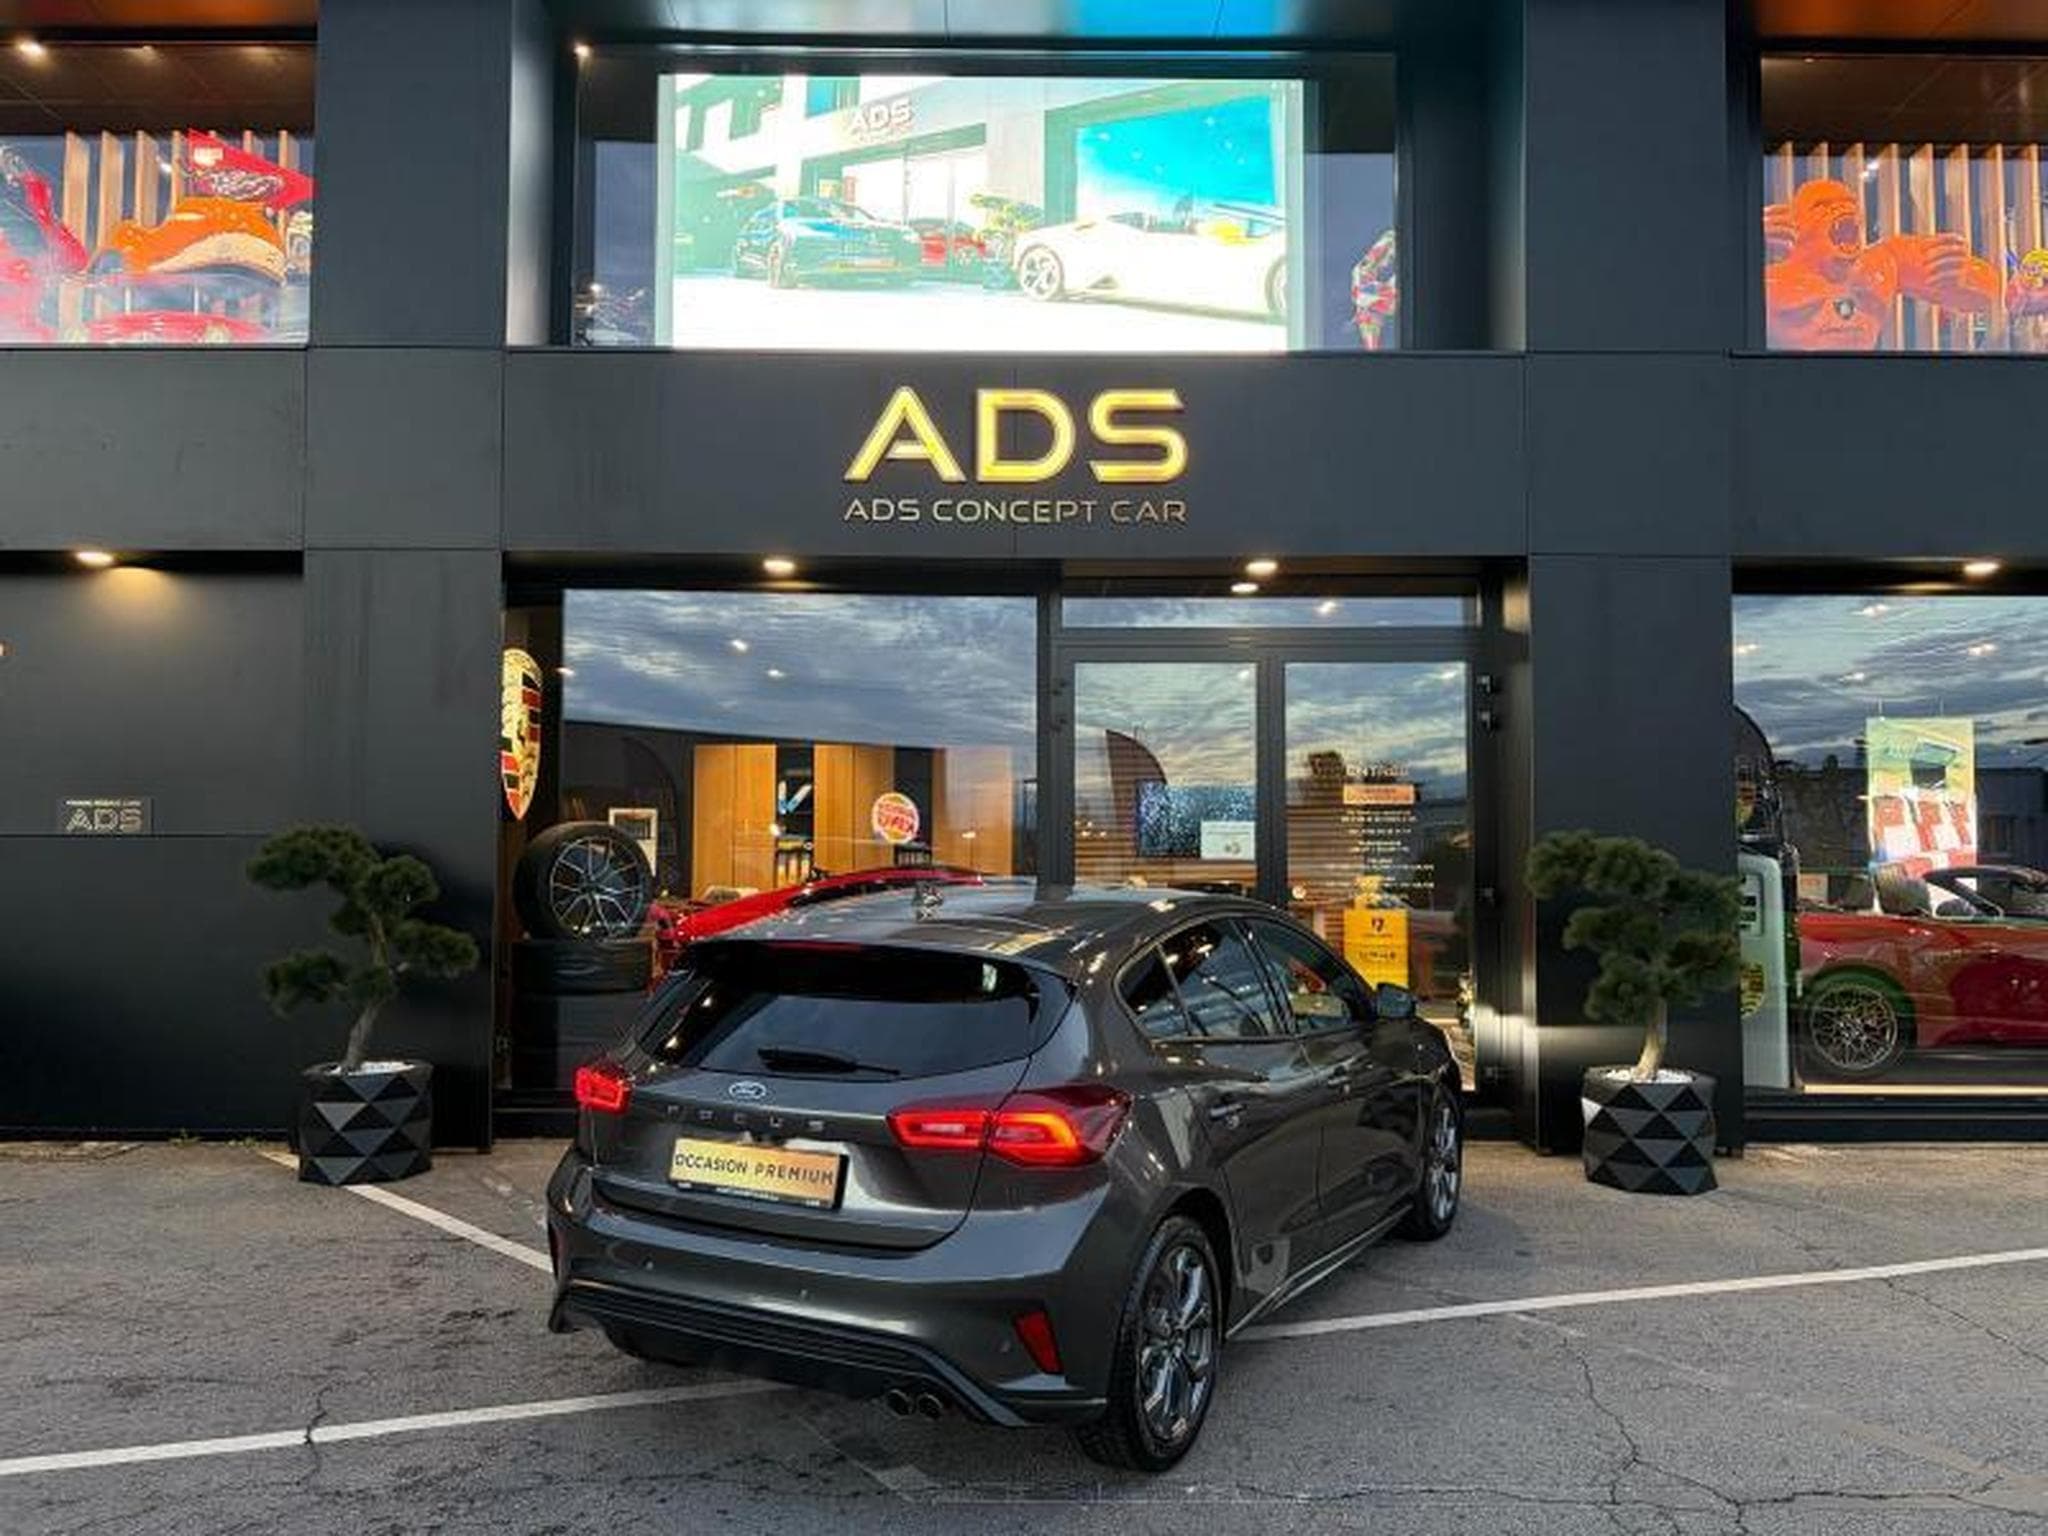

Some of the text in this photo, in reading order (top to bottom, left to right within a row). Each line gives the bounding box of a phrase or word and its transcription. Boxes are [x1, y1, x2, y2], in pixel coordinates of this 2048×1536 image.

[850, 100, 913, 131] ADS
[844, 386, 1188, 482] ADS
[844, 499, 1187, 523] ADS CONCEPT CAR
[66, 808, 142, 832] ADS
[674, 1153, 834, 1186] OCCASION PREMIUM
